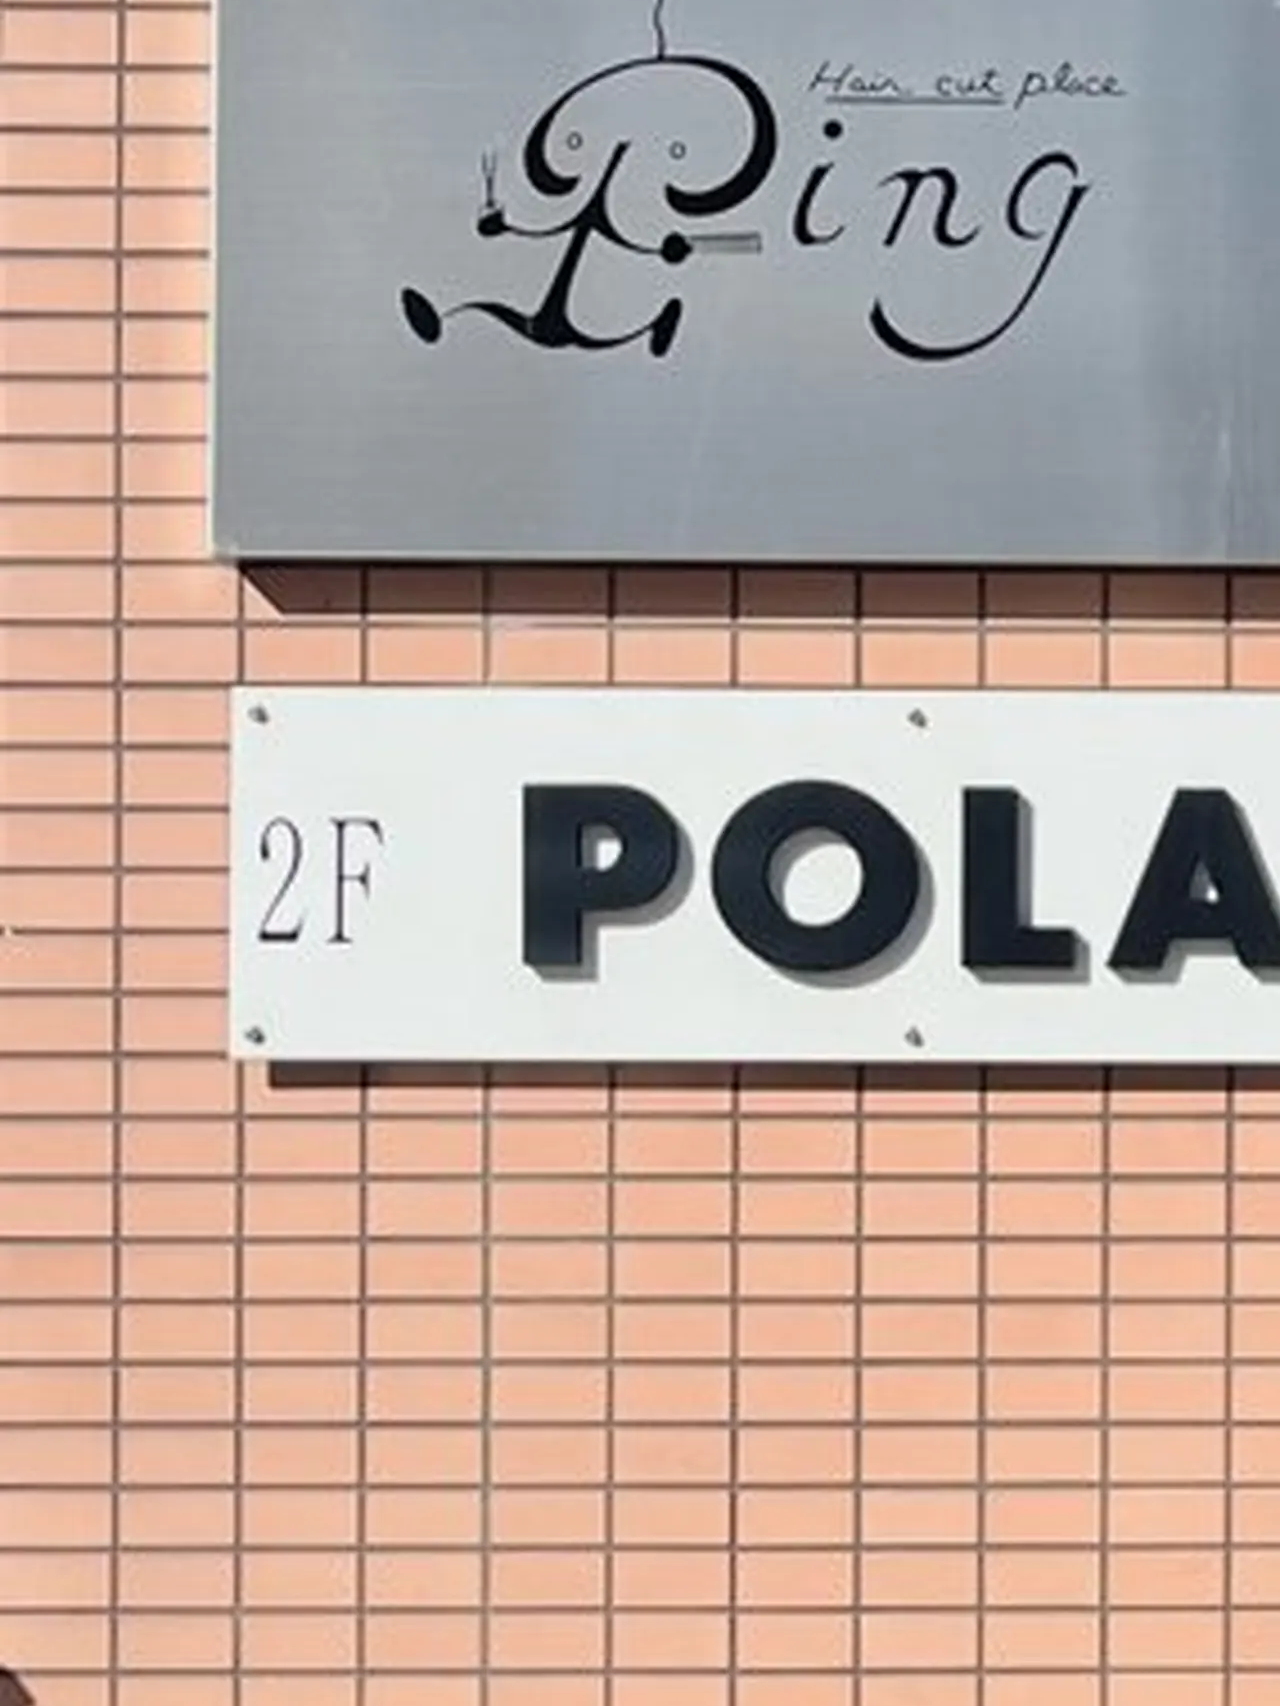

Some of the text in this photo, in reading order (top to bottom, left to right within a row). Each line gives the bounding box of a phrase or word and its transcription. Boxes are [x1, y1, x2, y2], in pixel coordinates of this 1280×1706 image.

[808, 60, 1127, 111] Hair cut place
[258, 816, 385, 945] 2F
